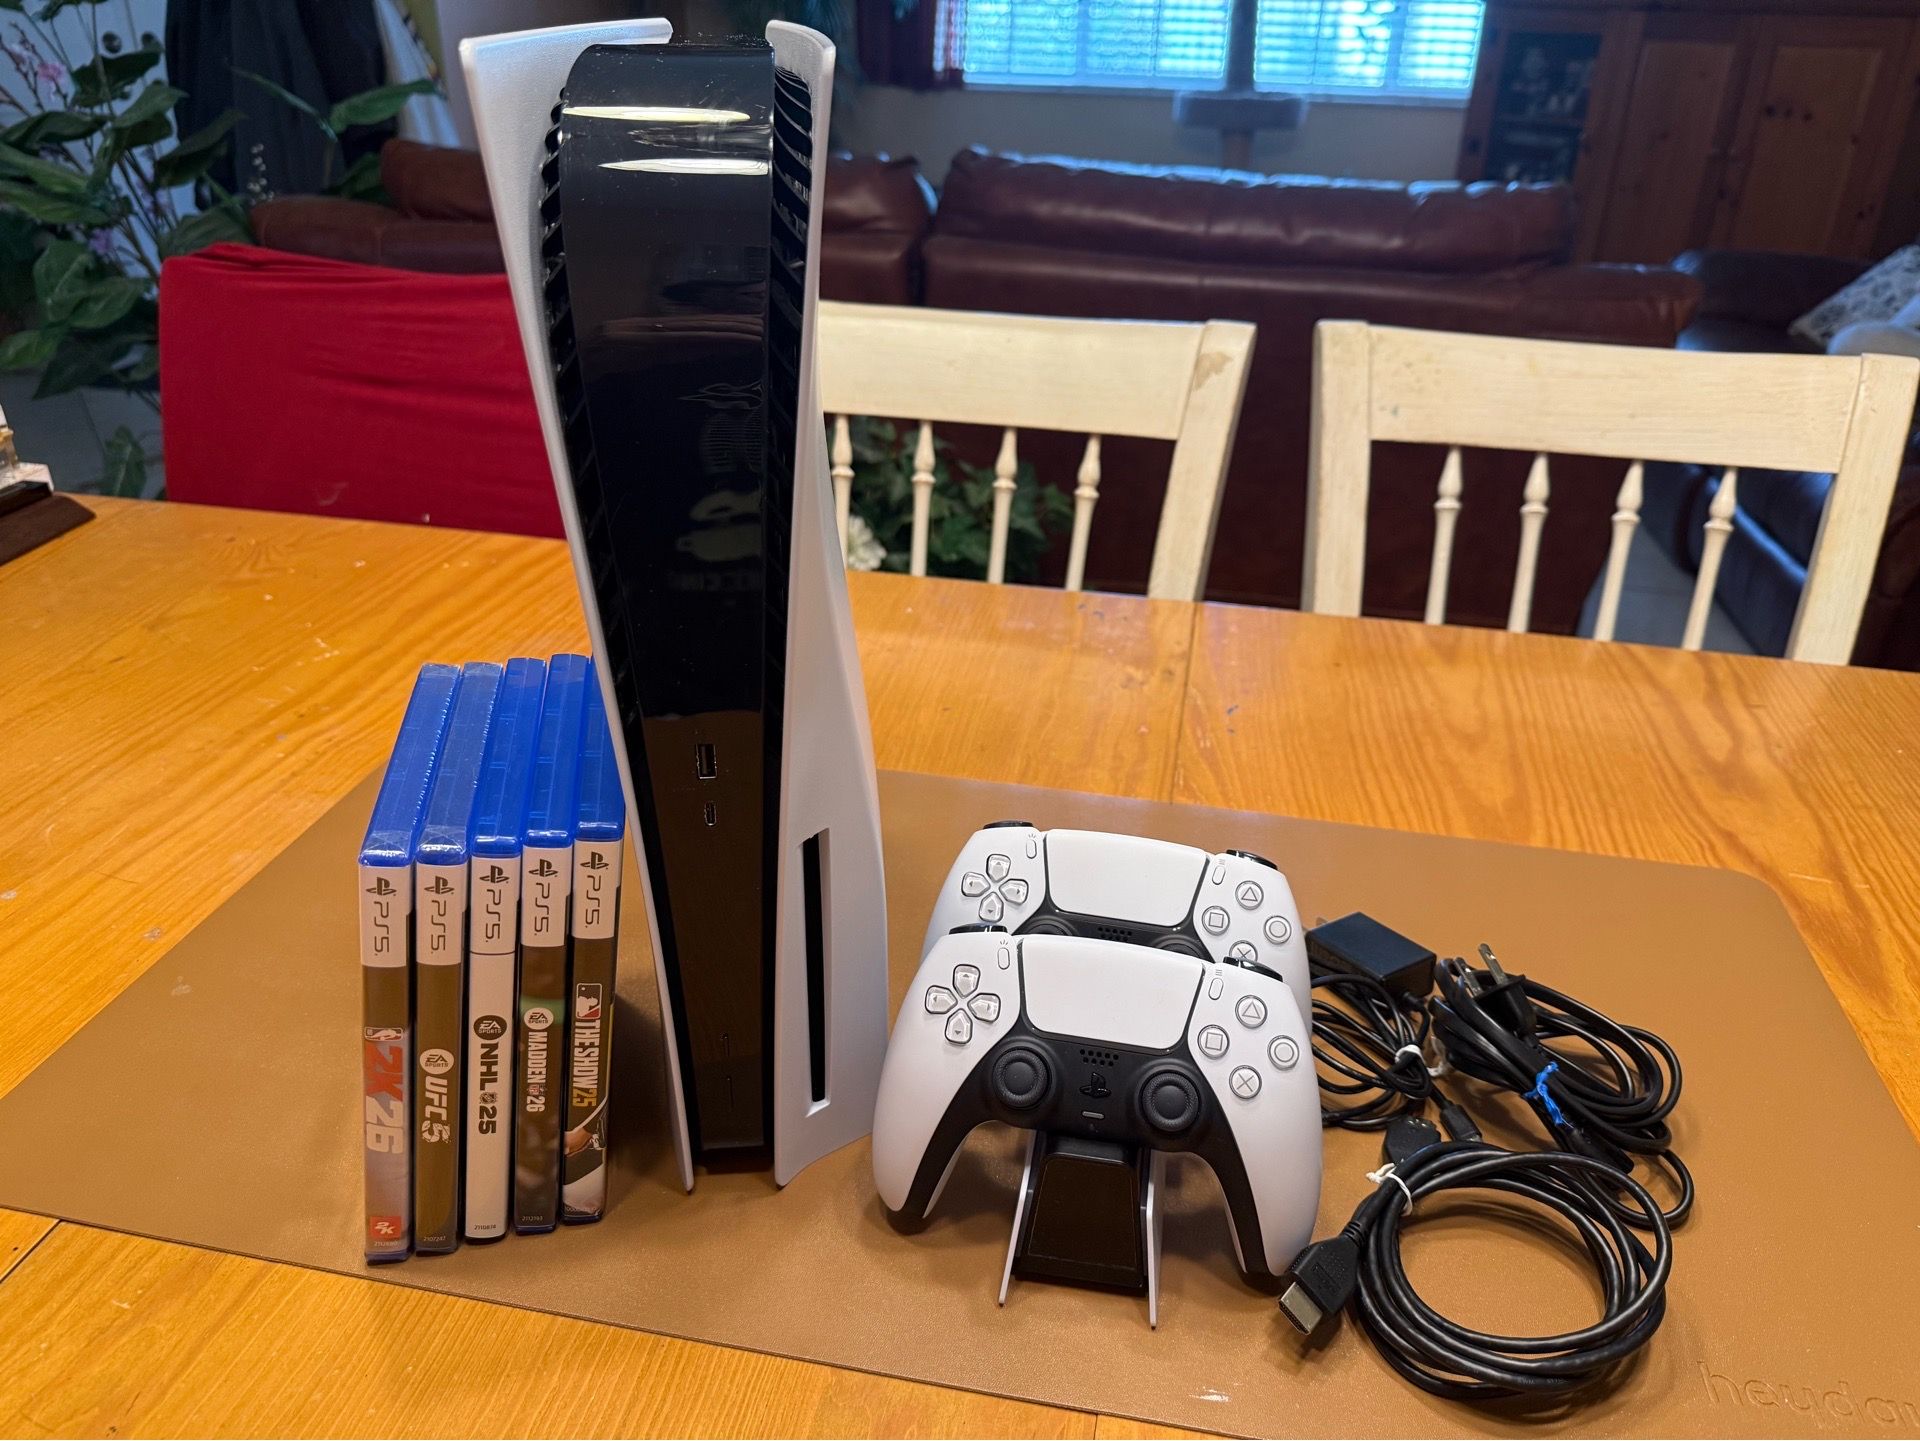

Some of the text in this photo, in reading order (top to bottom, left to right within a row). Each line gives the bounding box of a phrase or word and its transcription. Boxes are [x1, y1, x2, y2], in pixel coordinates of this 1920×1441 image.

[485, 888, 502, 940] PS5
[534, 882, 551, 933] PS5
[585, 874, 602, 925] PS5
[373, 900, 390, 954] PS5
[430, 899, 446, 952] PS5
[479, 1020, 501, 1029] EA
[529, 1012, 548, 1020] EA
[425, 1054, 448, 1063] EA
[479, 1041, 499, 1091] NHL
[527, 1031, 548, 1084] MADDEN
[478, 1105, 498, 1135] 25
[526, 1095, 546, 1112] 26
[374, 1221, 396, 1234] 2K
